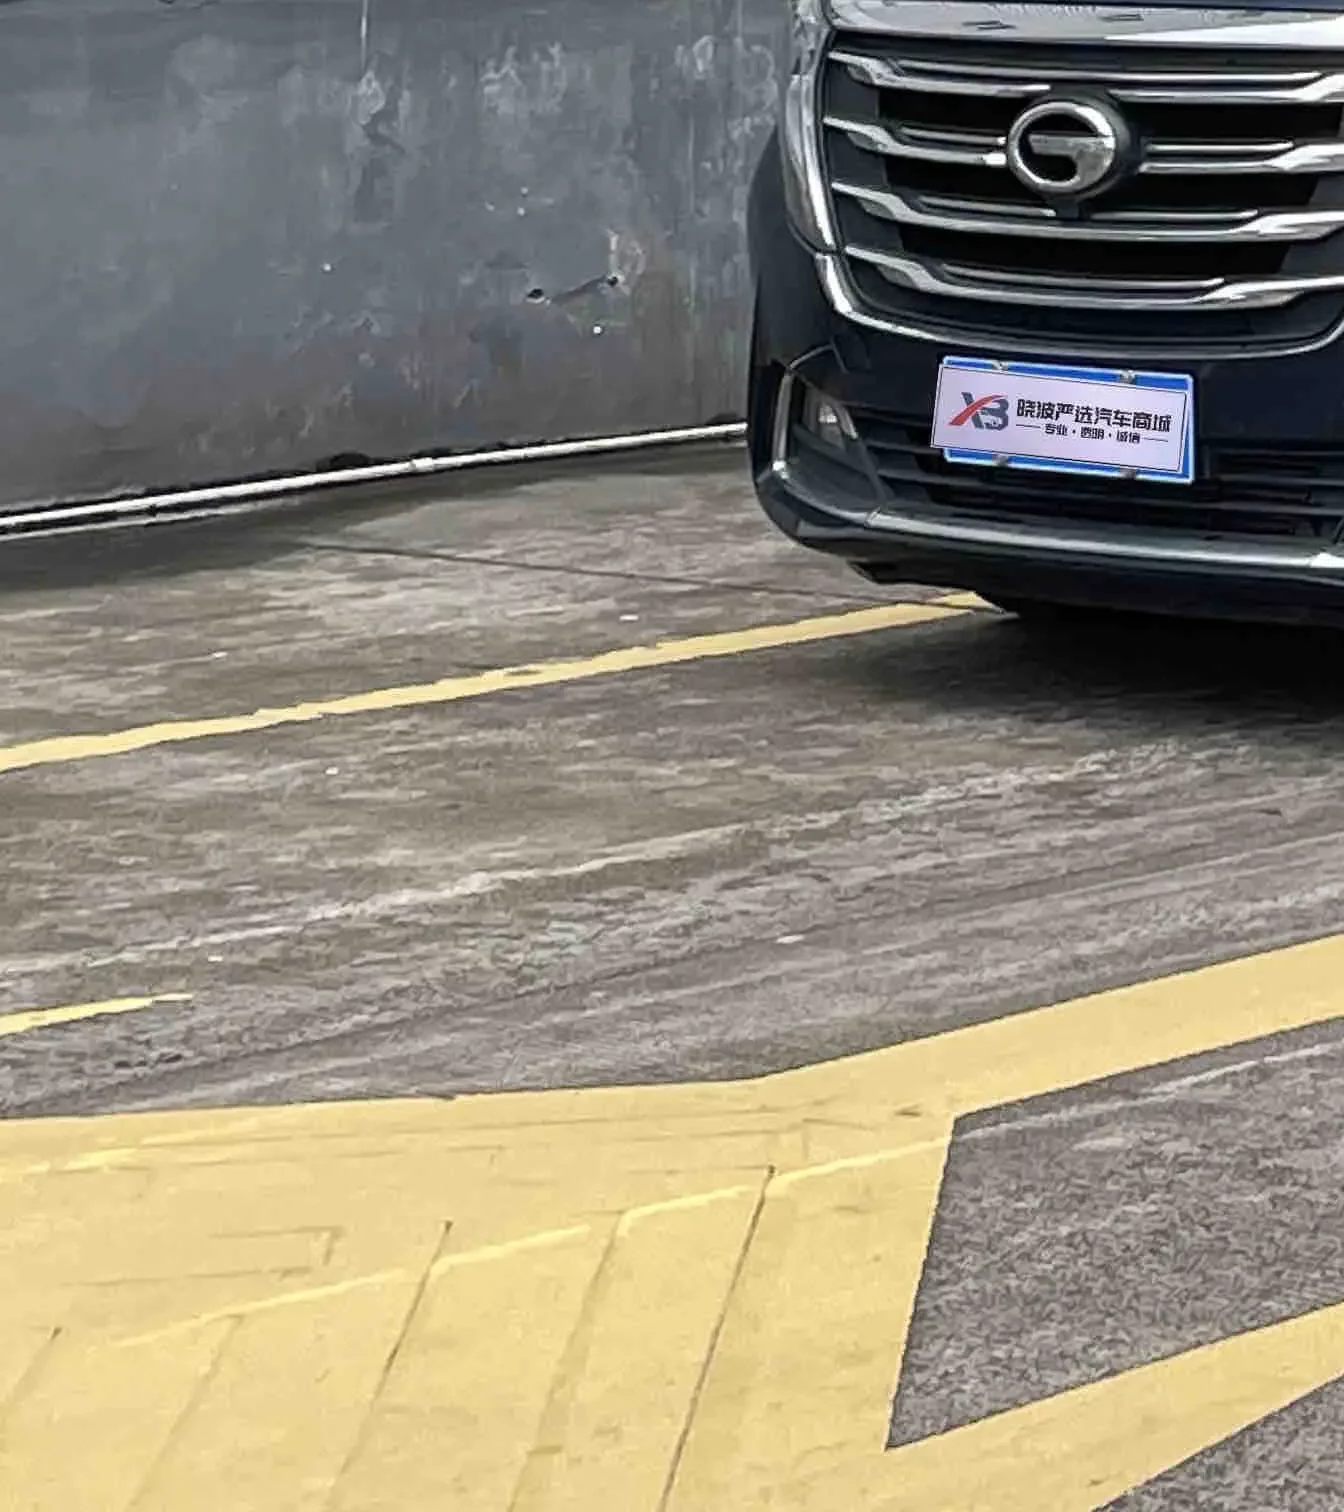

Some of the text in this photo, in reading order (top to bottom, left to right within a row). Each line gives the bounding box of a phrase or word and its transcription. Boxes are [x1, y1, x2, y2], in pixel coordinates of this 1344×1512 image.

[1015, 398, 1172, 433] 晓波严选汽车商城
